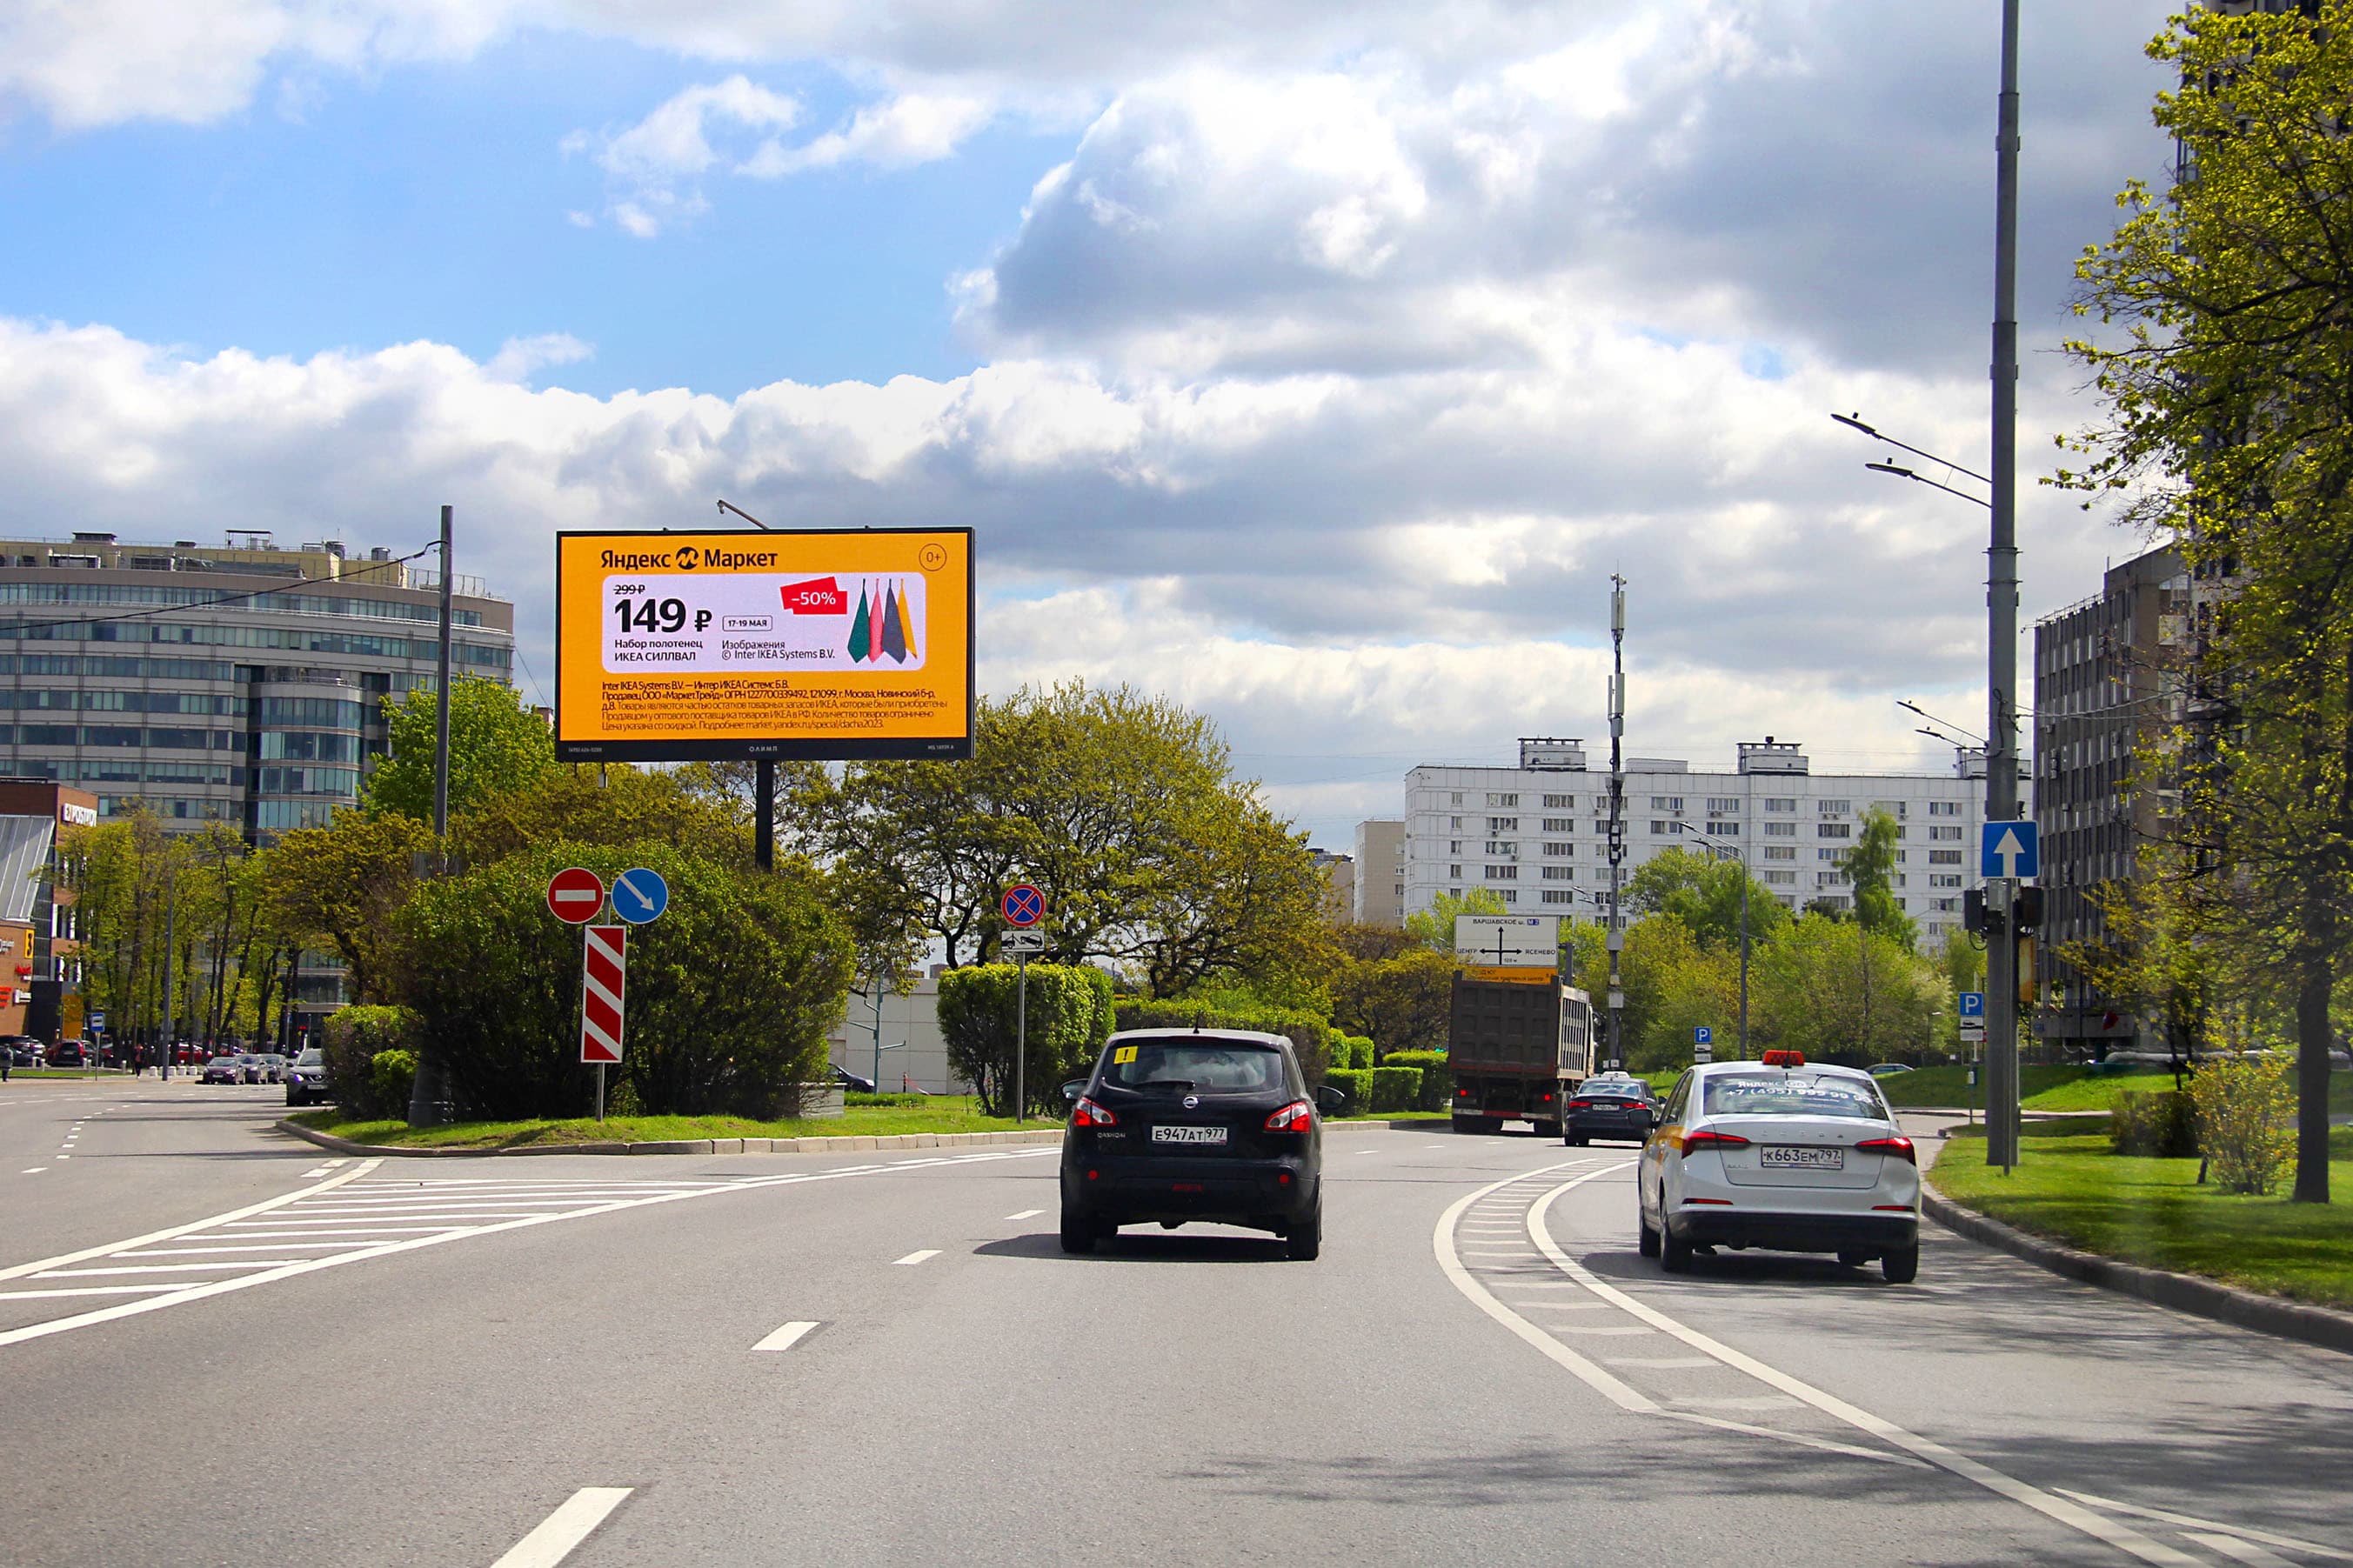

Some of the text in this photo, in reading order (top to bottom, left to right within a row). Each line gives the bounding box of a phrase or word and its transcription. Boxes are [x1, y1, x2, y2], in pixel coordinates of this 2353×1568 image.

[601, 549, 778, 570] Яндекс Маркет
[926, 551, 941, 563] 0+
[614, 598, 686, 633] 149
[614, 639, 703, 650] Набор полотенец
[722, 639, 785, 651] Изображения
[614, 651, 696, 662] ИКЕА СИЛЛВАЛ
[734, 650, 755, 660] Inter
[757, 650, 779, 659] IKEA
[779, 650, 818, 661] Systems
[819, 649, 835, 659] B.V.
[602, 681, 619, 691] Inter
[620, 681, 638, 691] IKEA
[694, 681, 719, 691] Интер
[720, 680, 741, 689] ИКЕА
[1966, 995, 1979, 1014] P
[1699, 1029, 1708, 1041] P
[1155, 1127, 1225, 1141] Е947АТ 977
[1766, 1149, 1839, 1163] К663ЕМ 797
